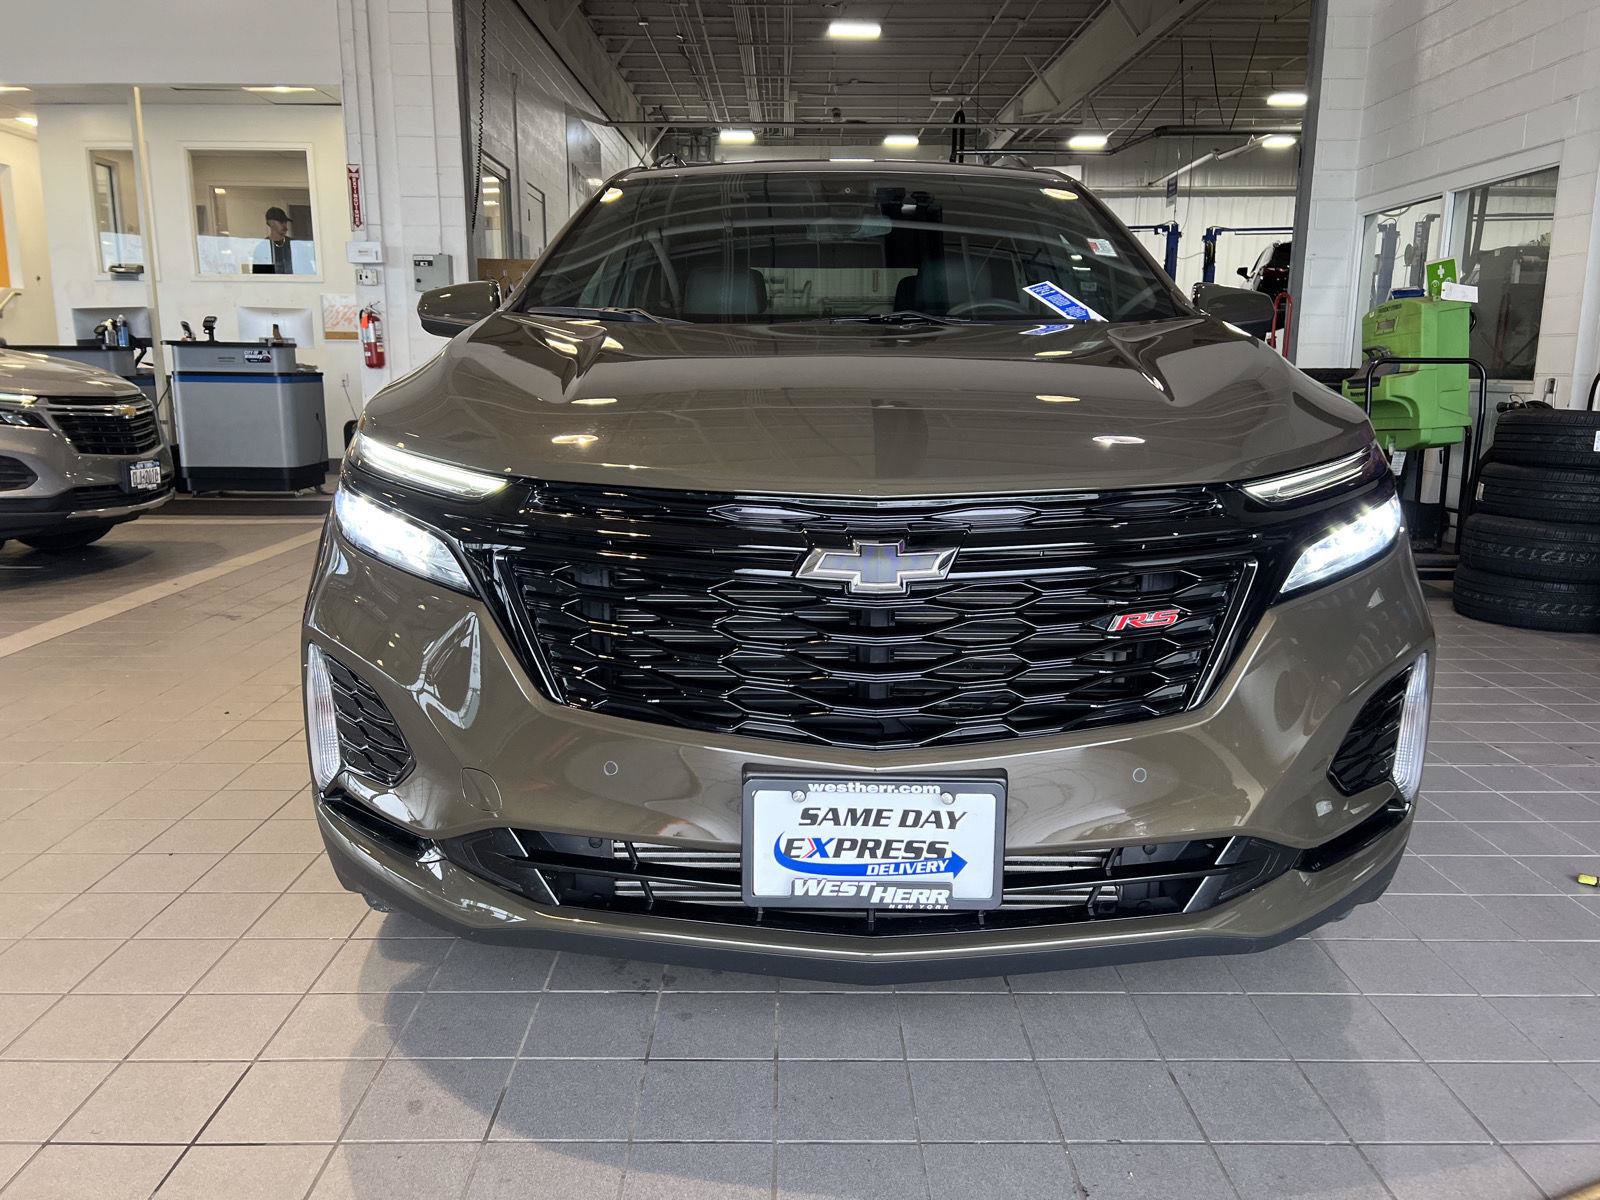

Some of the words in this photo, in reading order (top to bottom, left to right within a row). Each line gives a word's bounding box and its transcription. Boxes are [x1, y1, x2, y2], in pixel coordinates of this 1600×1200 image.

[1107, 609, 1181, 632] RS
[807, 782, 941, 794] westherr.com
[798, 807, 894, 827] SAME
[898, 809, 968, 830] DAY
[783, 837, 950, 860] EXPRESS
[866, 859, 949, 876] DELIVERY
